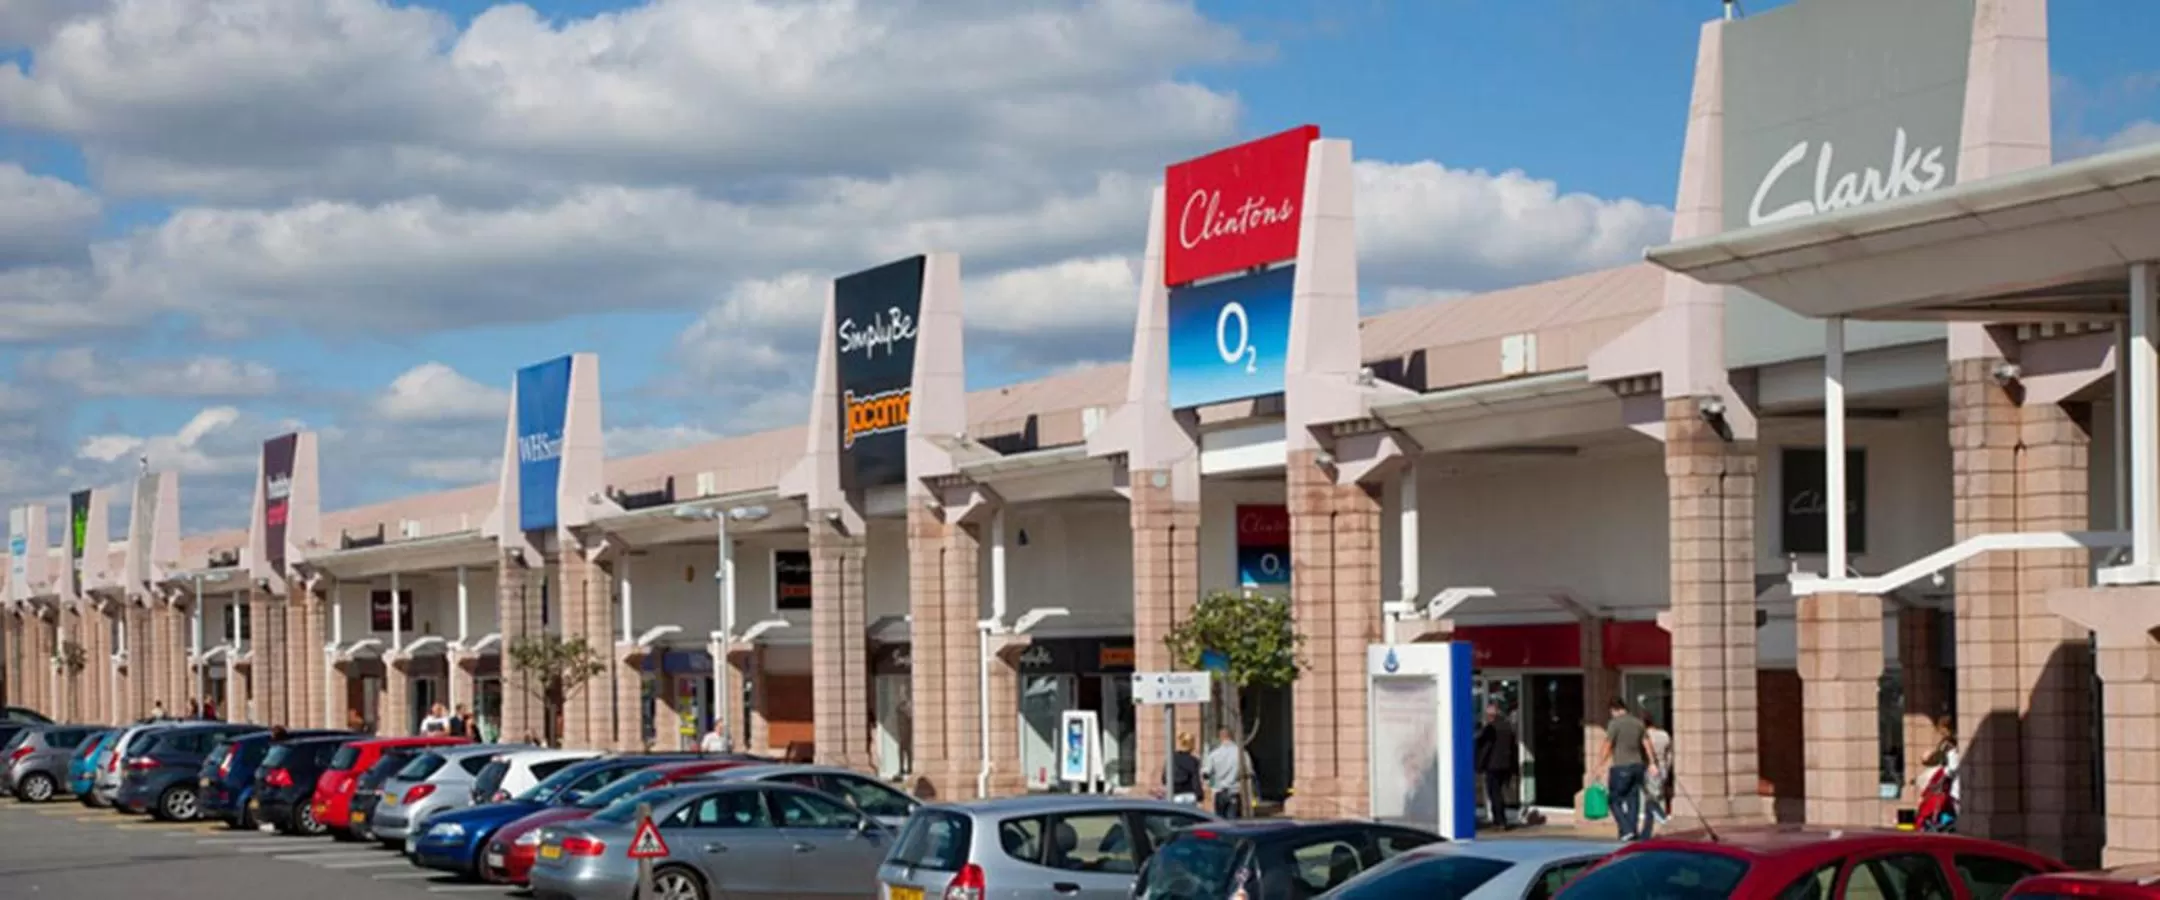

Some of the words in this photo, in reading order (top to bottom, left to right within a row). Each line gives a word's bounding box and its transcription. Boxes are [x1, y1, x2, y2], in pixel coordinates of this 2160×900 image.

[1748, 126, 1946, 226] Clarks
[1179, 189, 1294, 250] Clintons
[1216, 301, 1257, 374] O2
